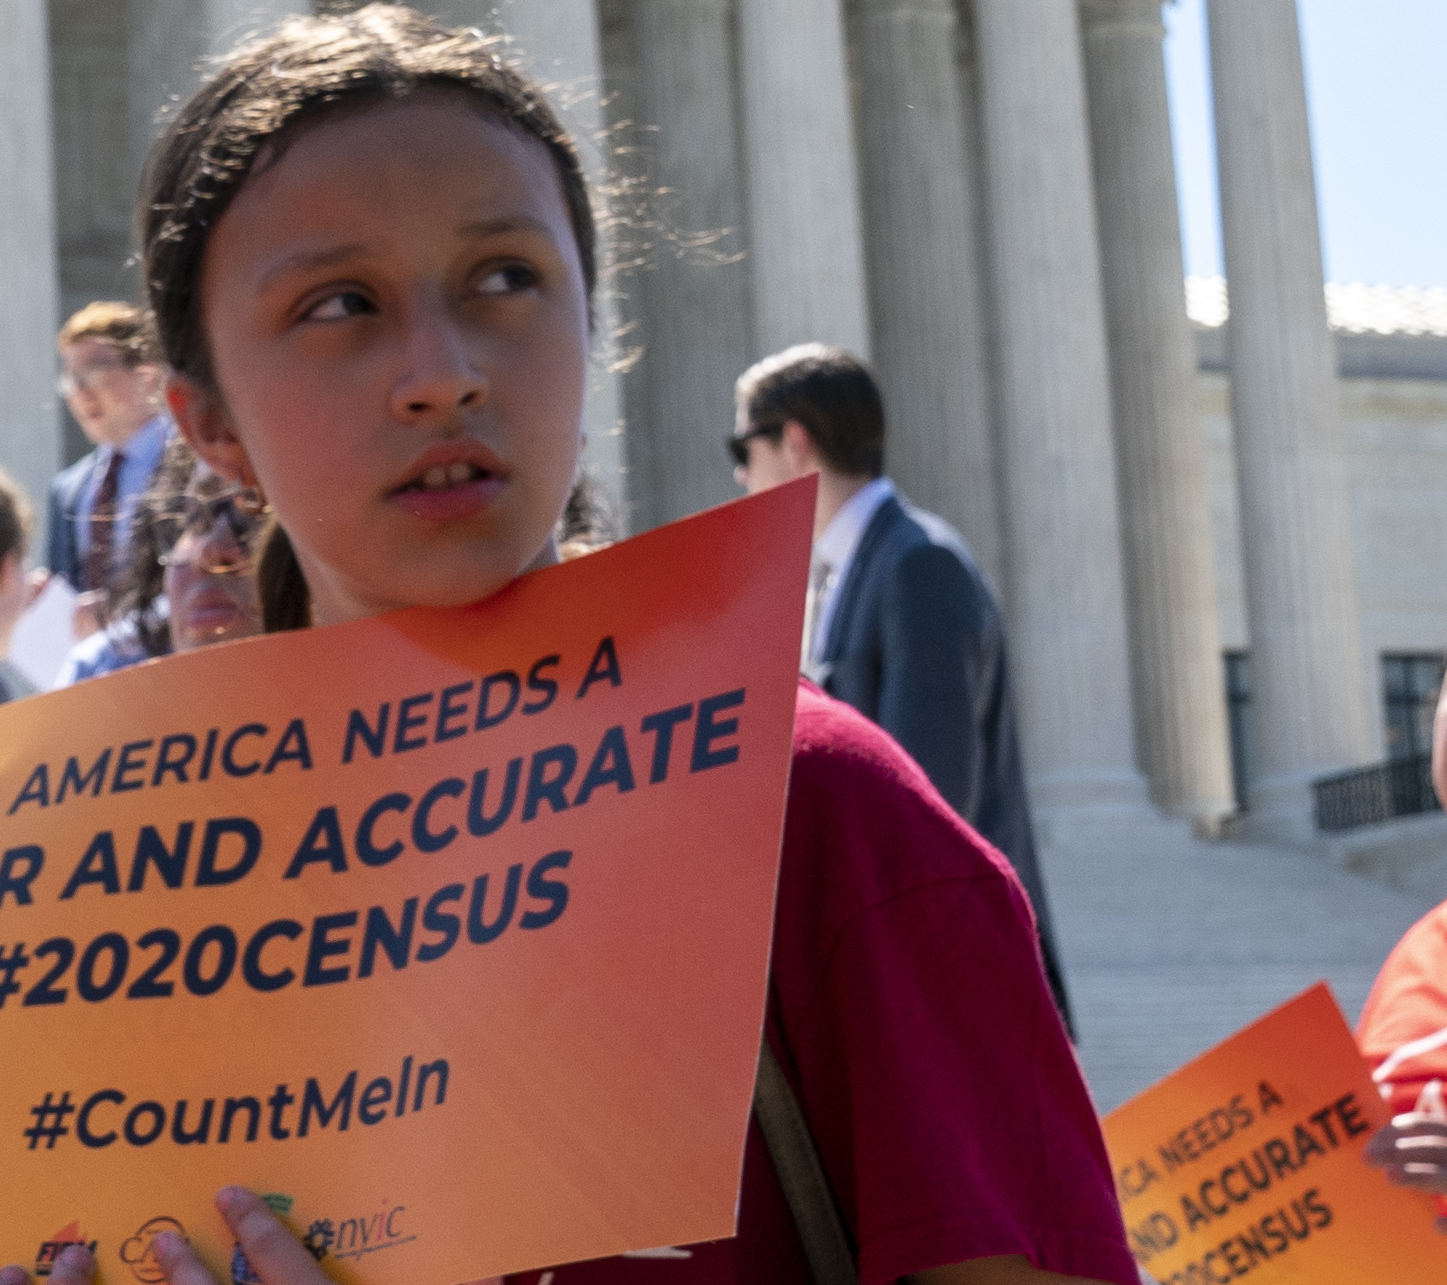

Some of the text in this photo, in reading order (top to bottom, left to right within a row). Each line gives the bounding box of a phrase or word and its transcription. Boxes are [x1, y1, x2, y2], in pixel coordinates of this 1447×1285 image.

[7, 636, 623, 817] AMERICA NEEDS A
[58, 816, 263, 901] AND
[283, 688, 746, 880] ACCURATE
[23, 1055, 450, 1151] #CountMeIn
[1119, 1079, 1284, 1199] CA NEEDS A
[1131, 1093, 1370, 1262] ND ACCURATE
[36, 1240, 97, 1263] FI
